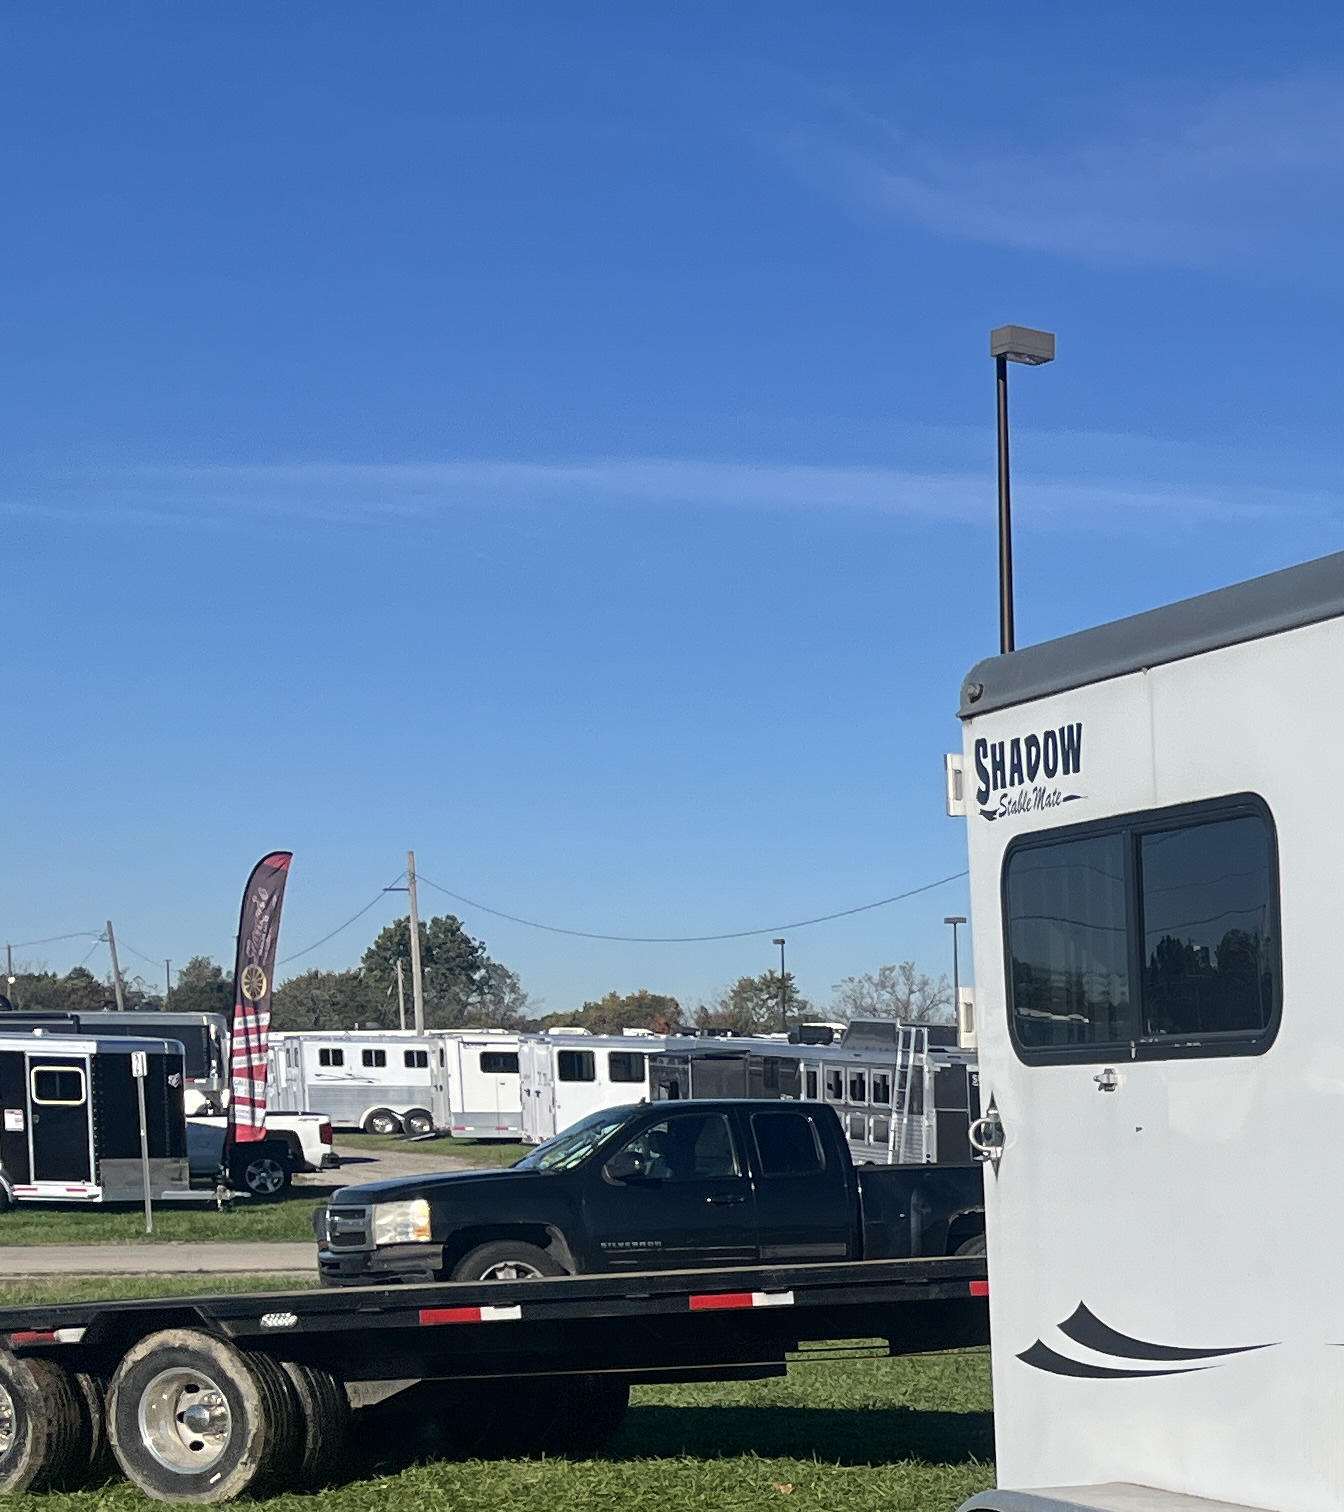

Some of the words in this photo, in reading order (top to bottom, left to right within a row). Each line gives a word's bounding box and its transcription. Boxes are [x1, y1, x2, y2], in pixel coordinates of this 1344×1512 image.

[974, 722, 1083, 806] SHADOW
[998, 788, 1032, 818] Stable
[1032, 785, 1062, 812] Mate
